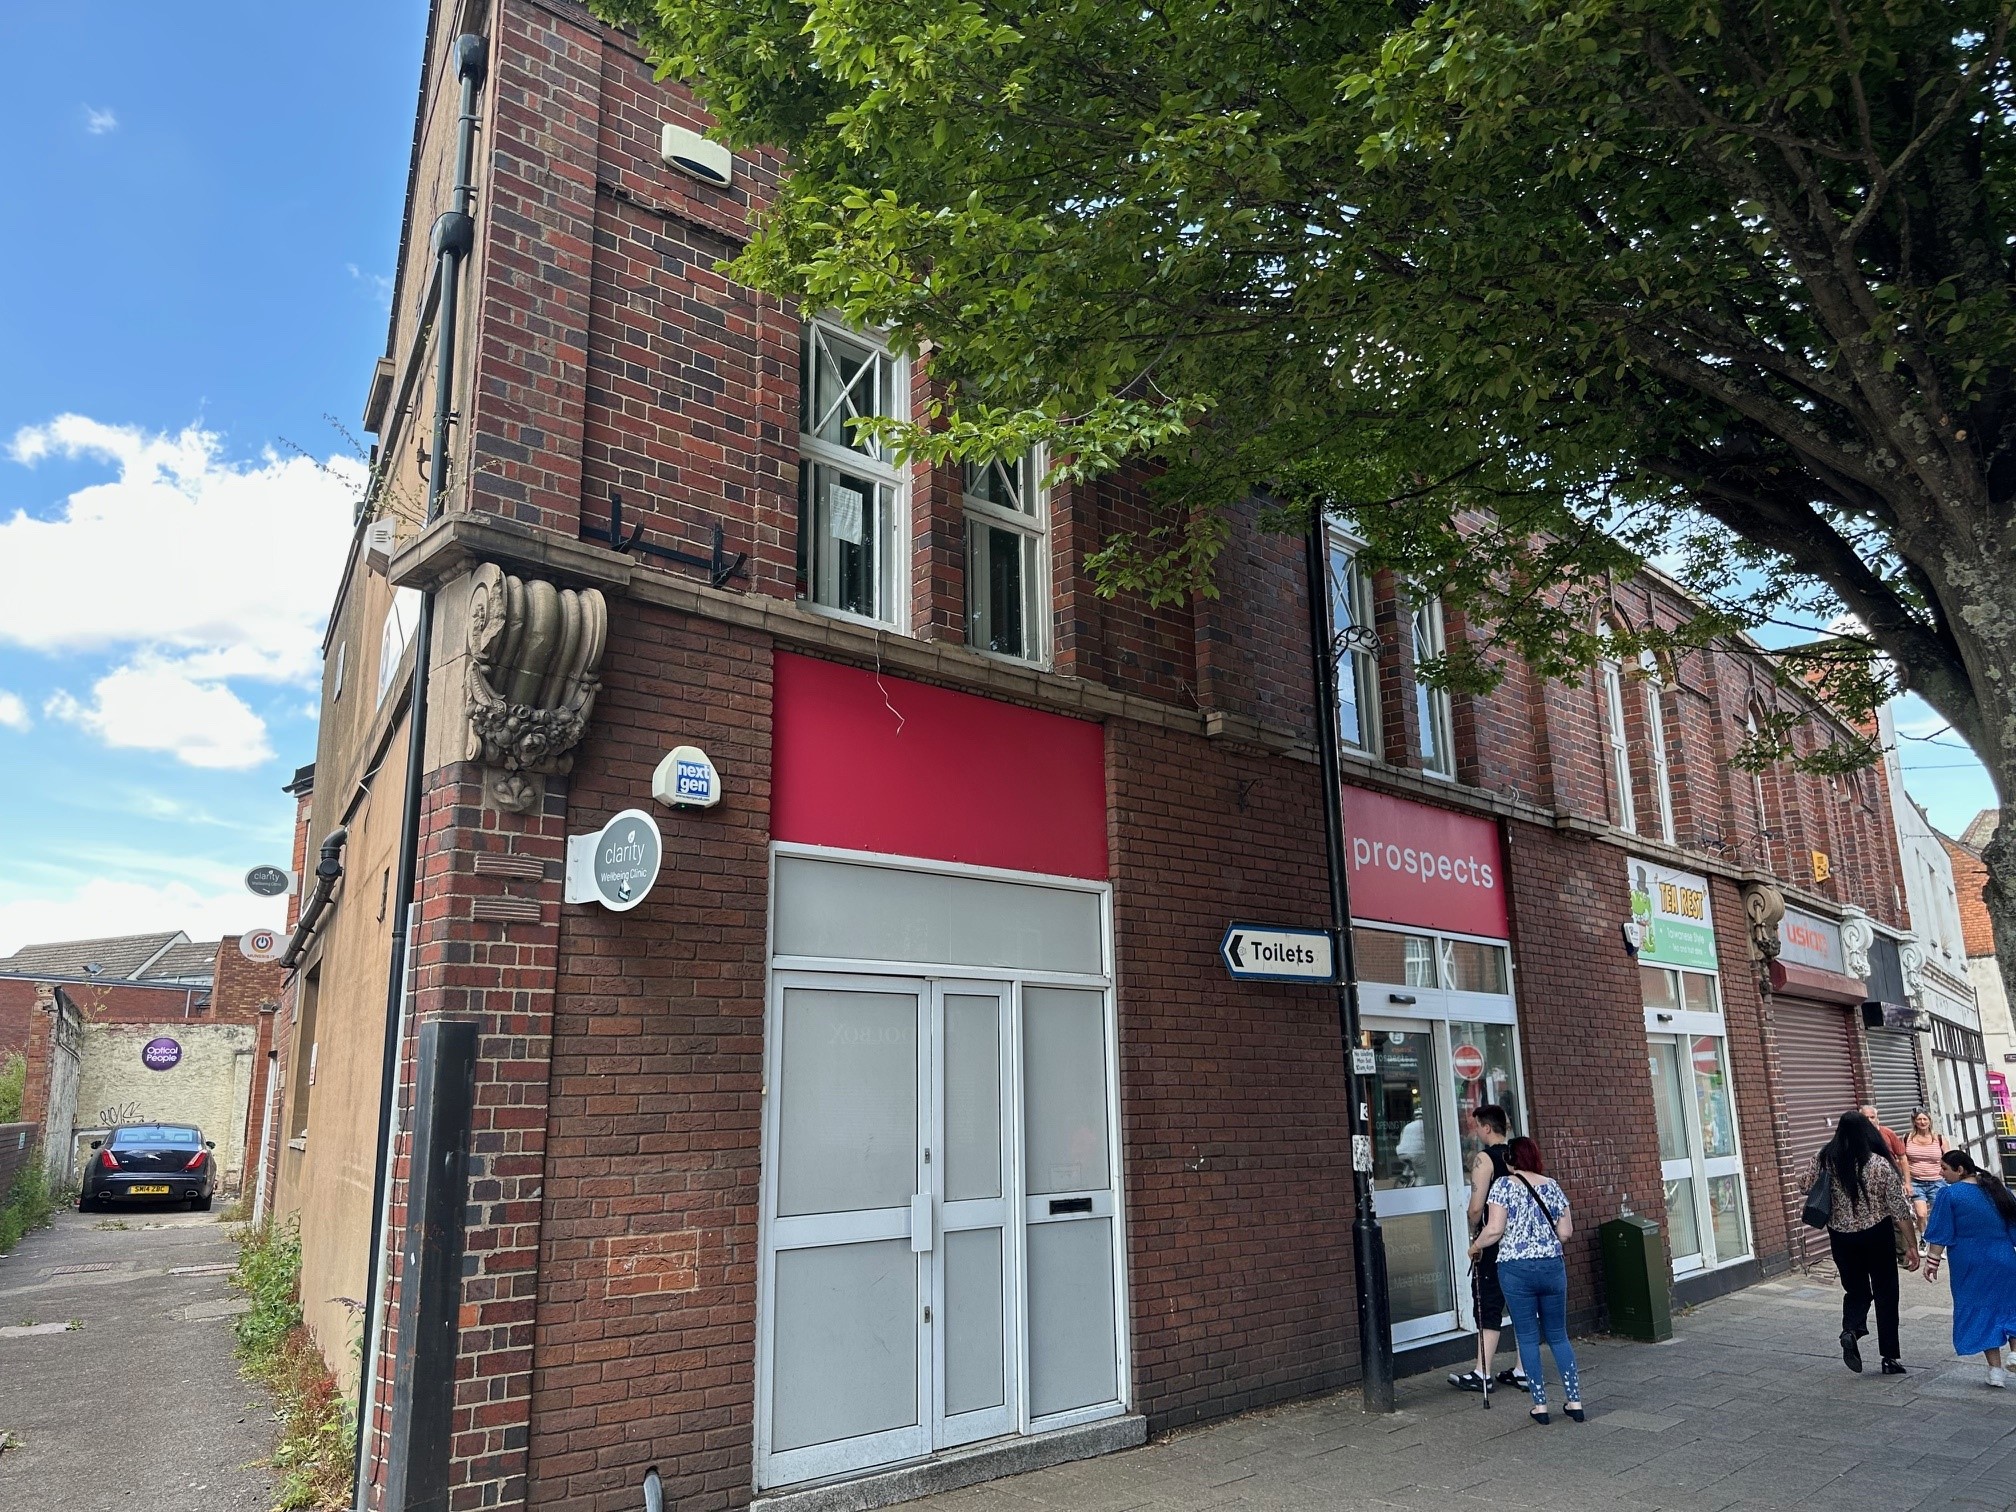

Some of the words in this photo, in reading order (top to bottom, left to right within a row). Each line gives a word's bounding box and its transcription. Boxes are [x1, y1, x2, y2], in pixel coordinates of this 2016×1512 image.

[677, 764, 710, 780] next
[680, 778, 708, 793] gen
[605, 841, 646, 866] clarity
[1353, 837, 1494, 889] prospects
[253, 870, 280, 882] clarity
[600, 870, 630, 882] Wellbeing
[630, 868, 648, 879] Clinic
[1659, 882, 1679, 915] TEA
[1679, 886, 1704, 920] REST
[1251, 941, 1314, 965] Toilets
[146, 1046, 178, 1055] Optical
[146, 1054, 178, 1063] People
